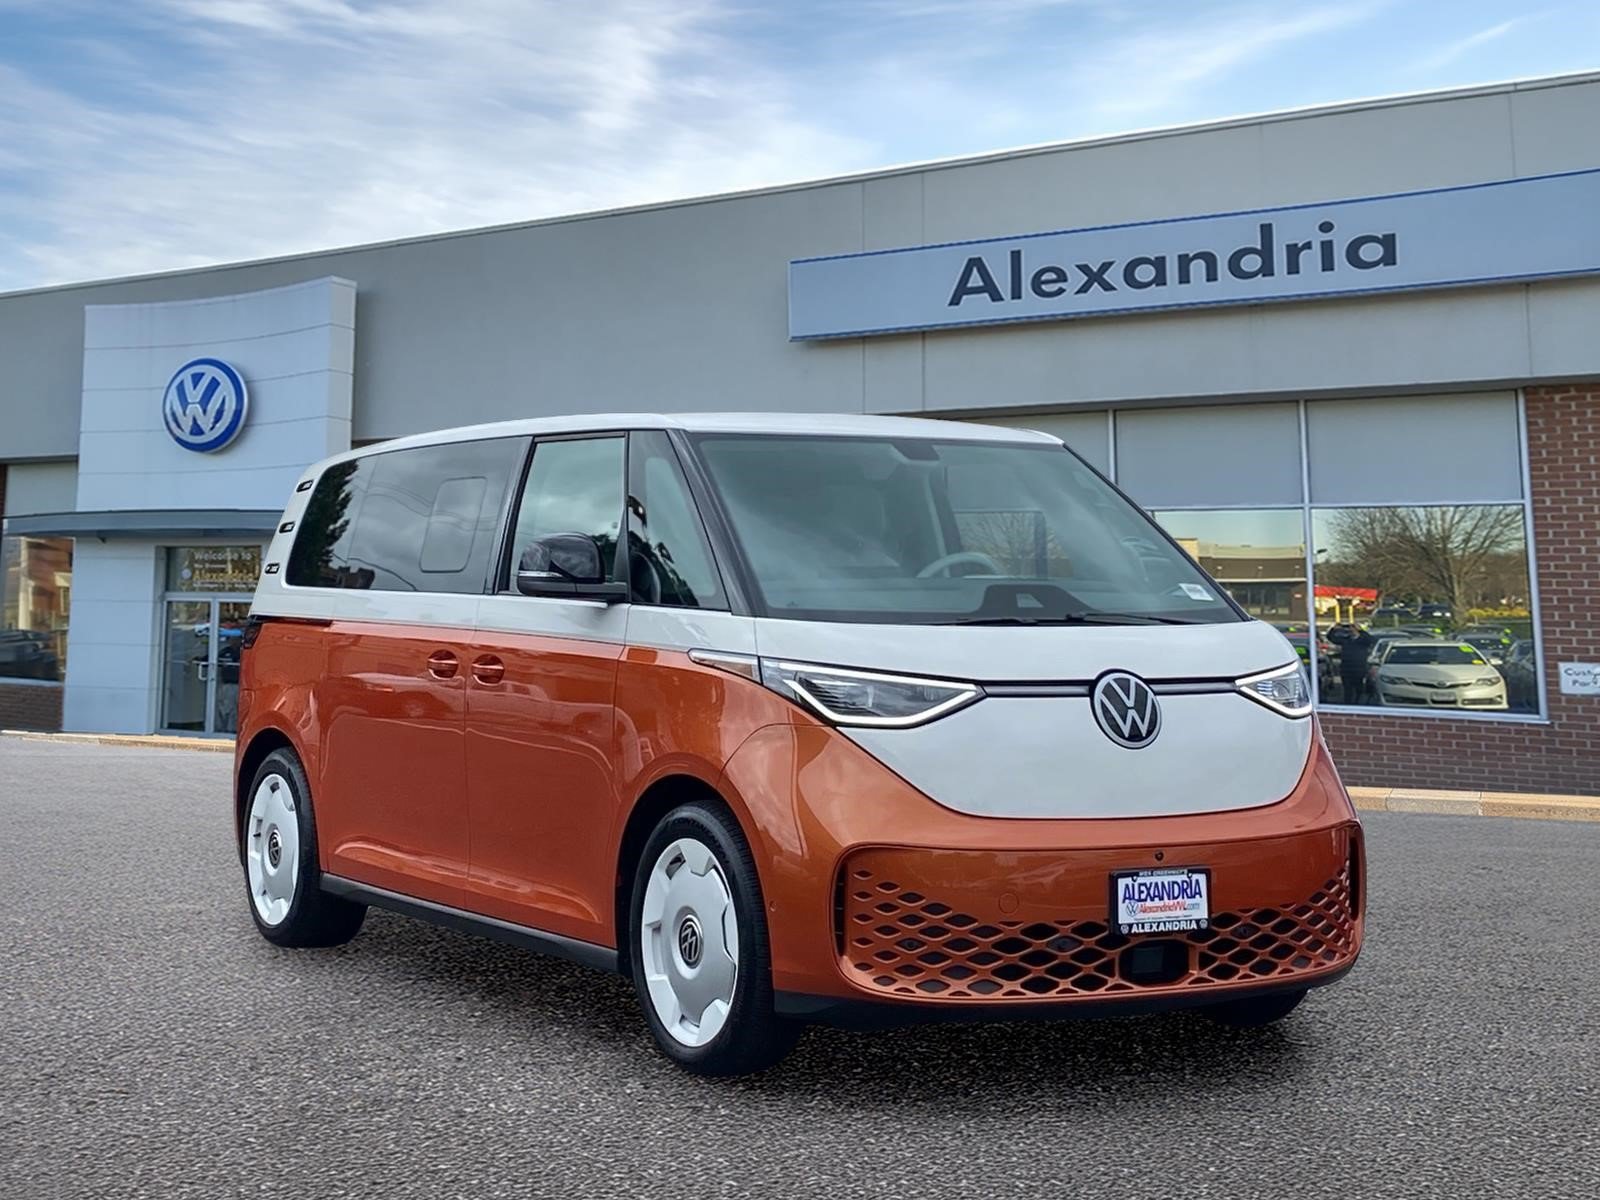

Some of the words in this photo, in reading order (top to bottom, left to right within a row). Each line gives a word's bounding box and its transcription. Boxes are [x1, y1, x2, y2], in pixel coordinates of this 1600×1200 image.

[948, 221, 1398, 306] Alexandria
[1123, 879, 1203, 903] ALEXANDRIA
[1131, 920, 1198, 934] ALEXANDRIA
